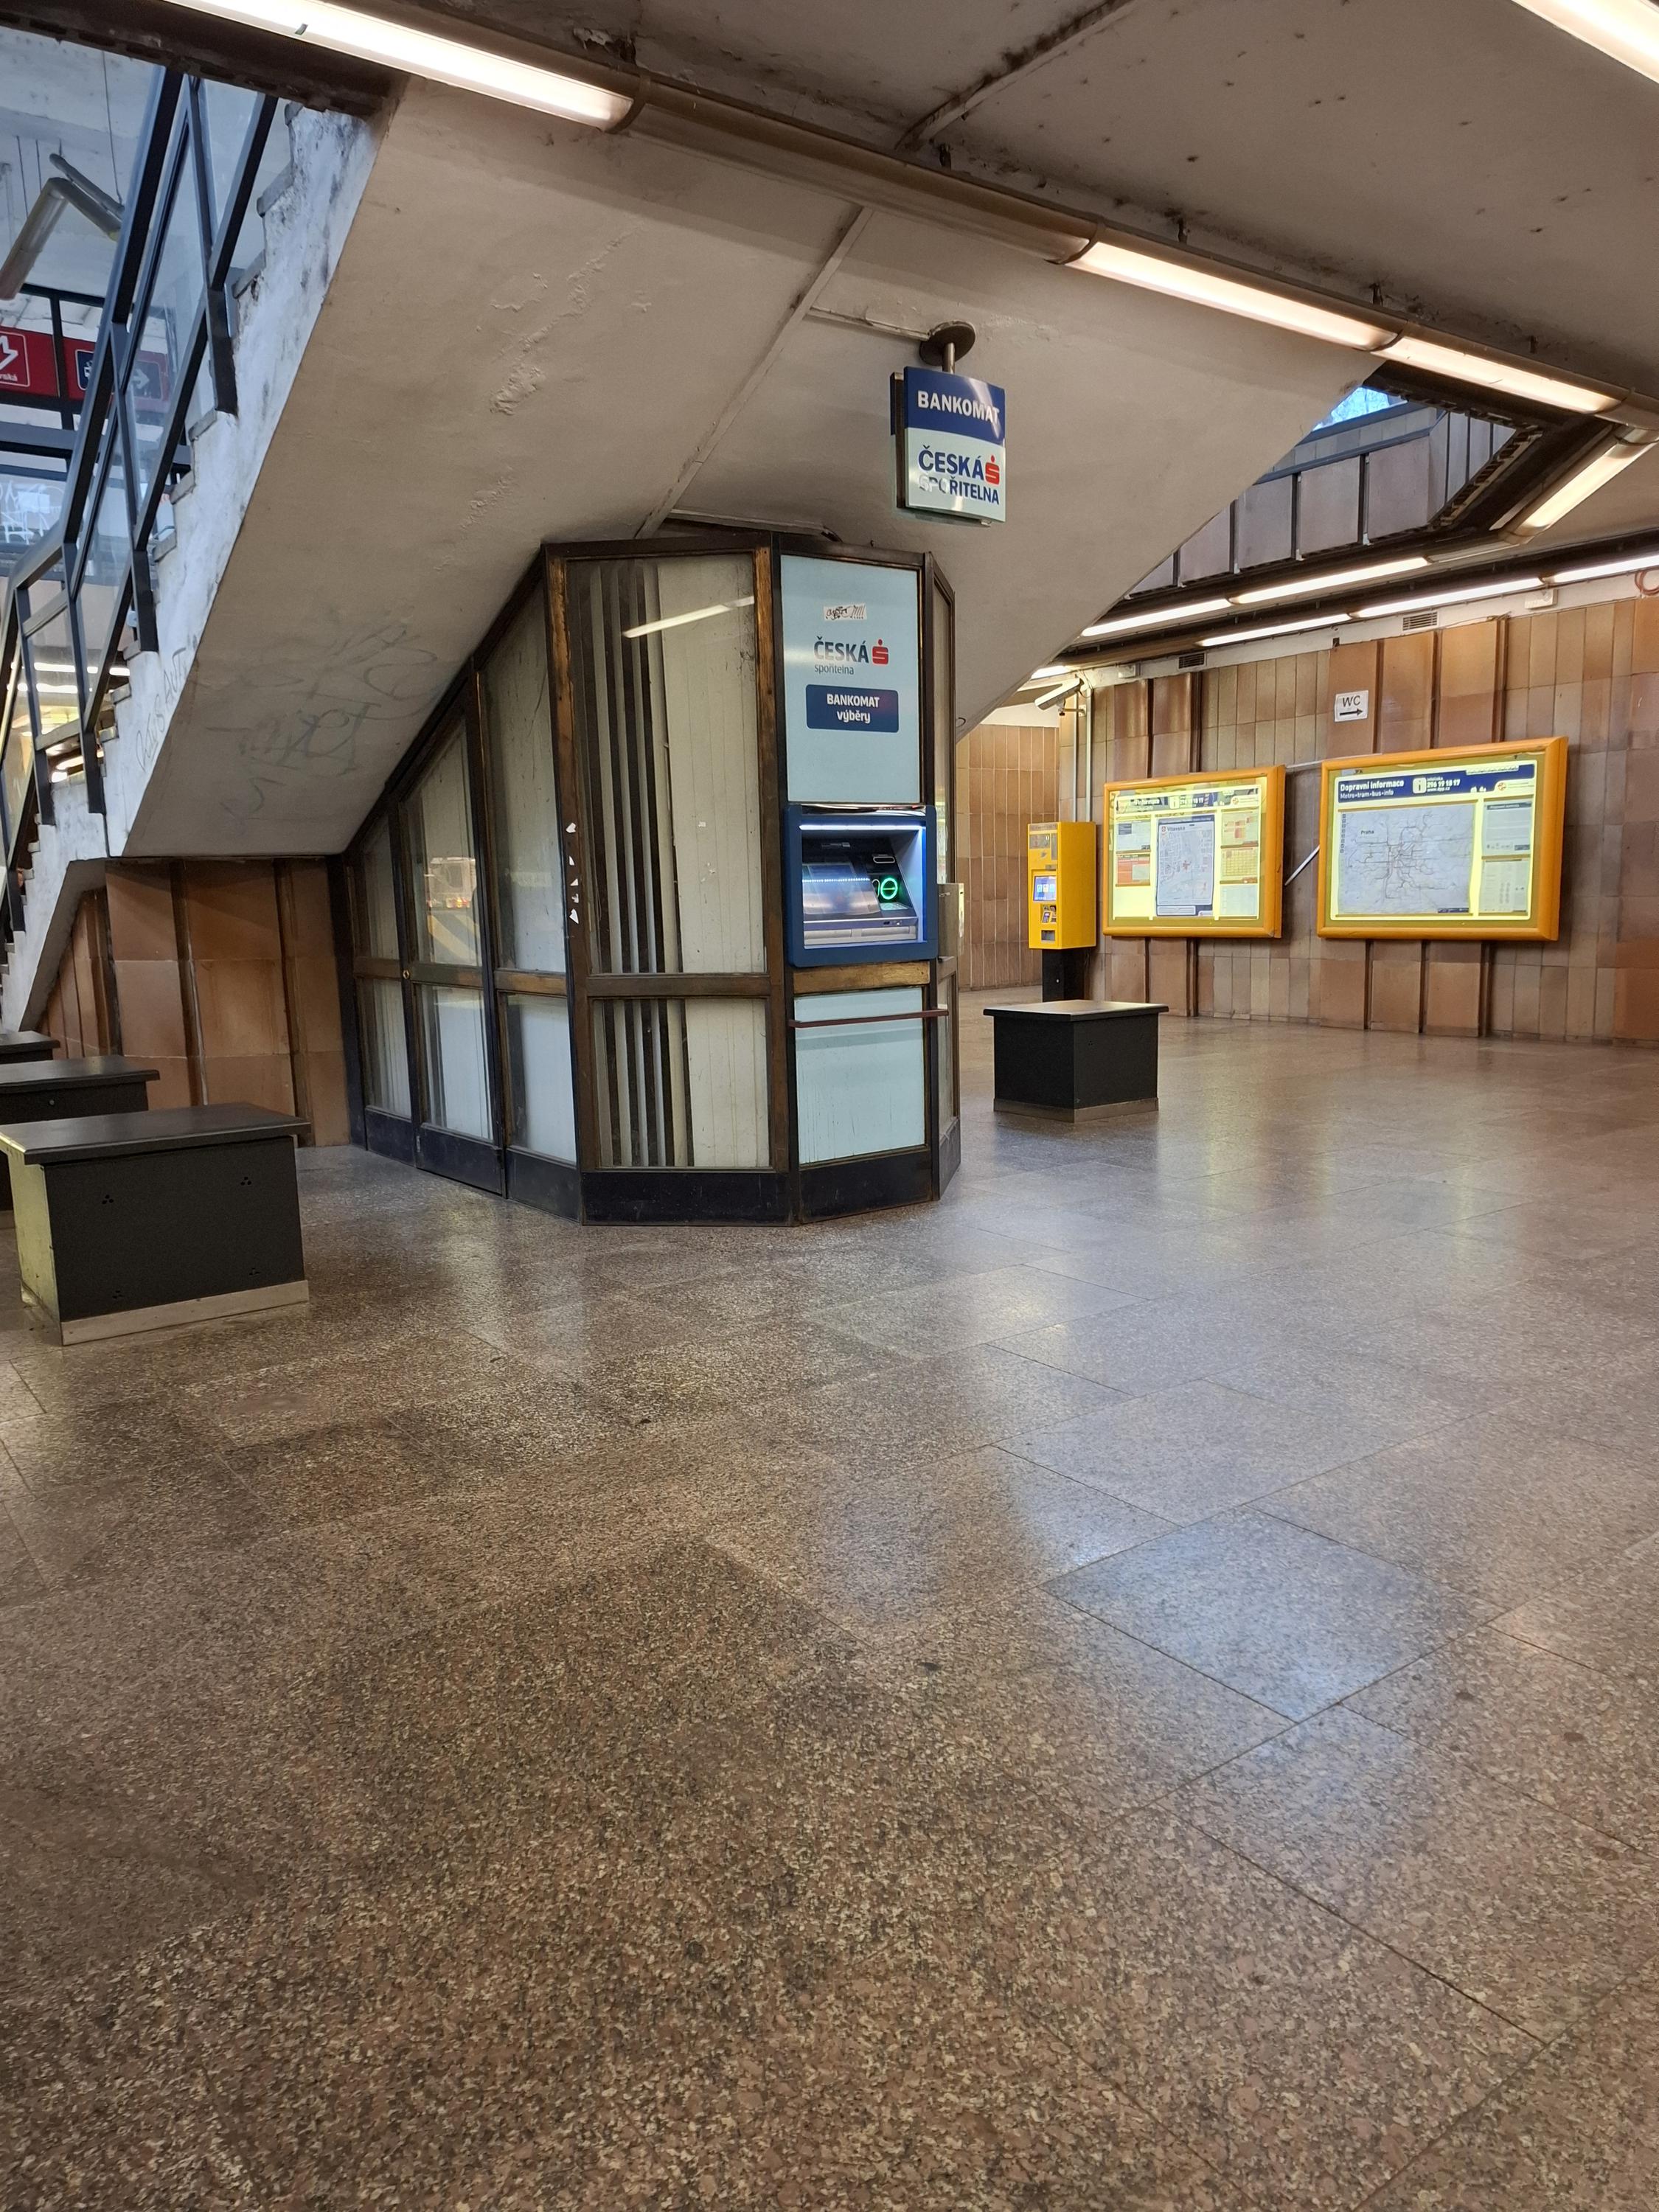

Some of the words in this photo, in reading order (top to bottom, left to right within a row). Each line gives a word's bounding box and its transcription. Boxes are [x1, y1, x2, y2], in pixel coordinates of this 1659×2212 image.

[917, 391, 1000, 425] BANKOMAT
[918, 445, 984, 481] ČESKÁ
[919, 475, 1000, 505] SPOŘITELNA
[813, 636, 869, 664] ČESKÁ
[814, 663, 855, 675] spořitelna
[827, 693, 880, 708] BANKOMAT
[1342, 695, 1361, 707] WC
[837, 709, 871, 724] výběry
[1340, 782, 1369, 792] Dopravní
